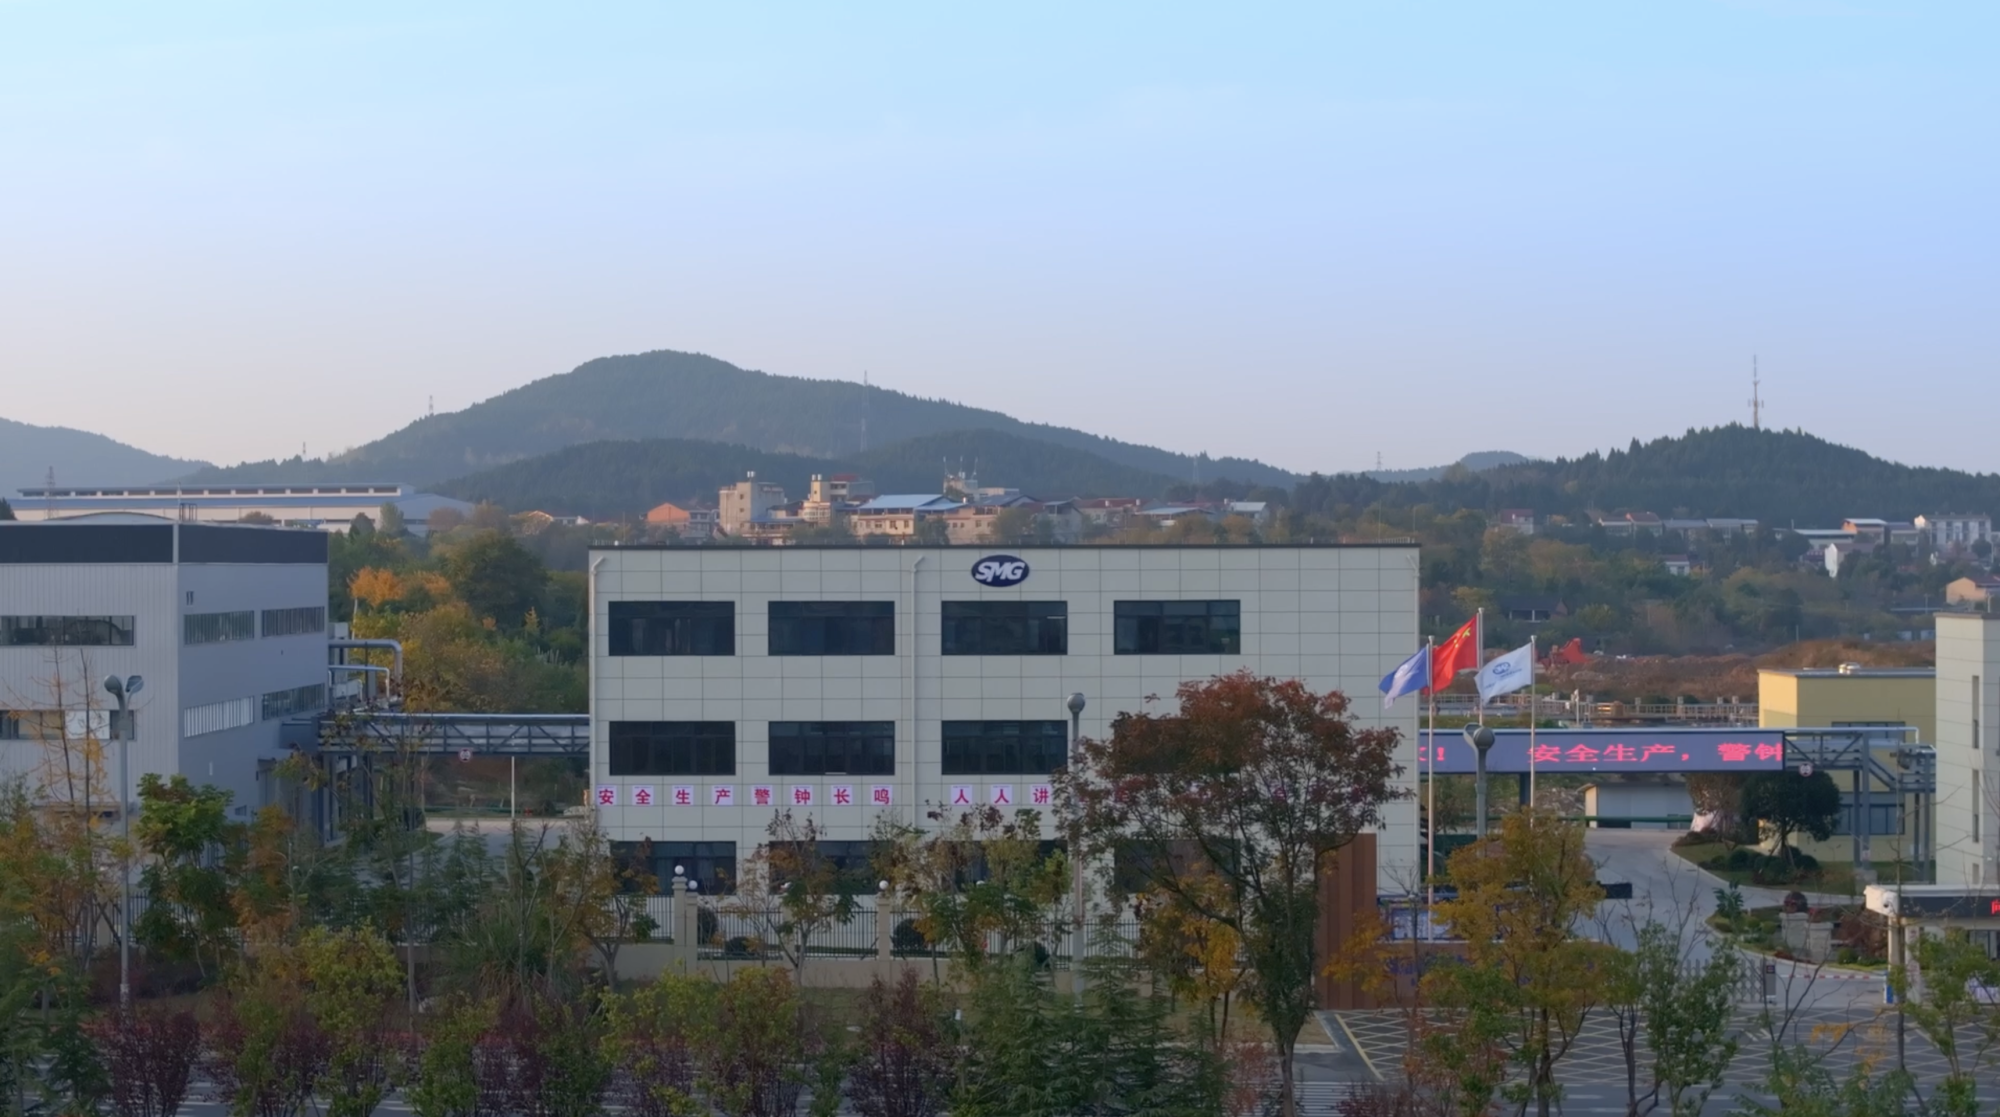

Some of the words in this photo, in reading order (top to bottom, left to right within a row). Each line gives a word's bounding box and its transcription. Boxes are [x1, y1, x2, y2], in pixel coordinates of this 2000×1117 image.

[976, 561, 1026, 582] SMG
[598, 788, 889, 805] 安全生产警钟长鸣
